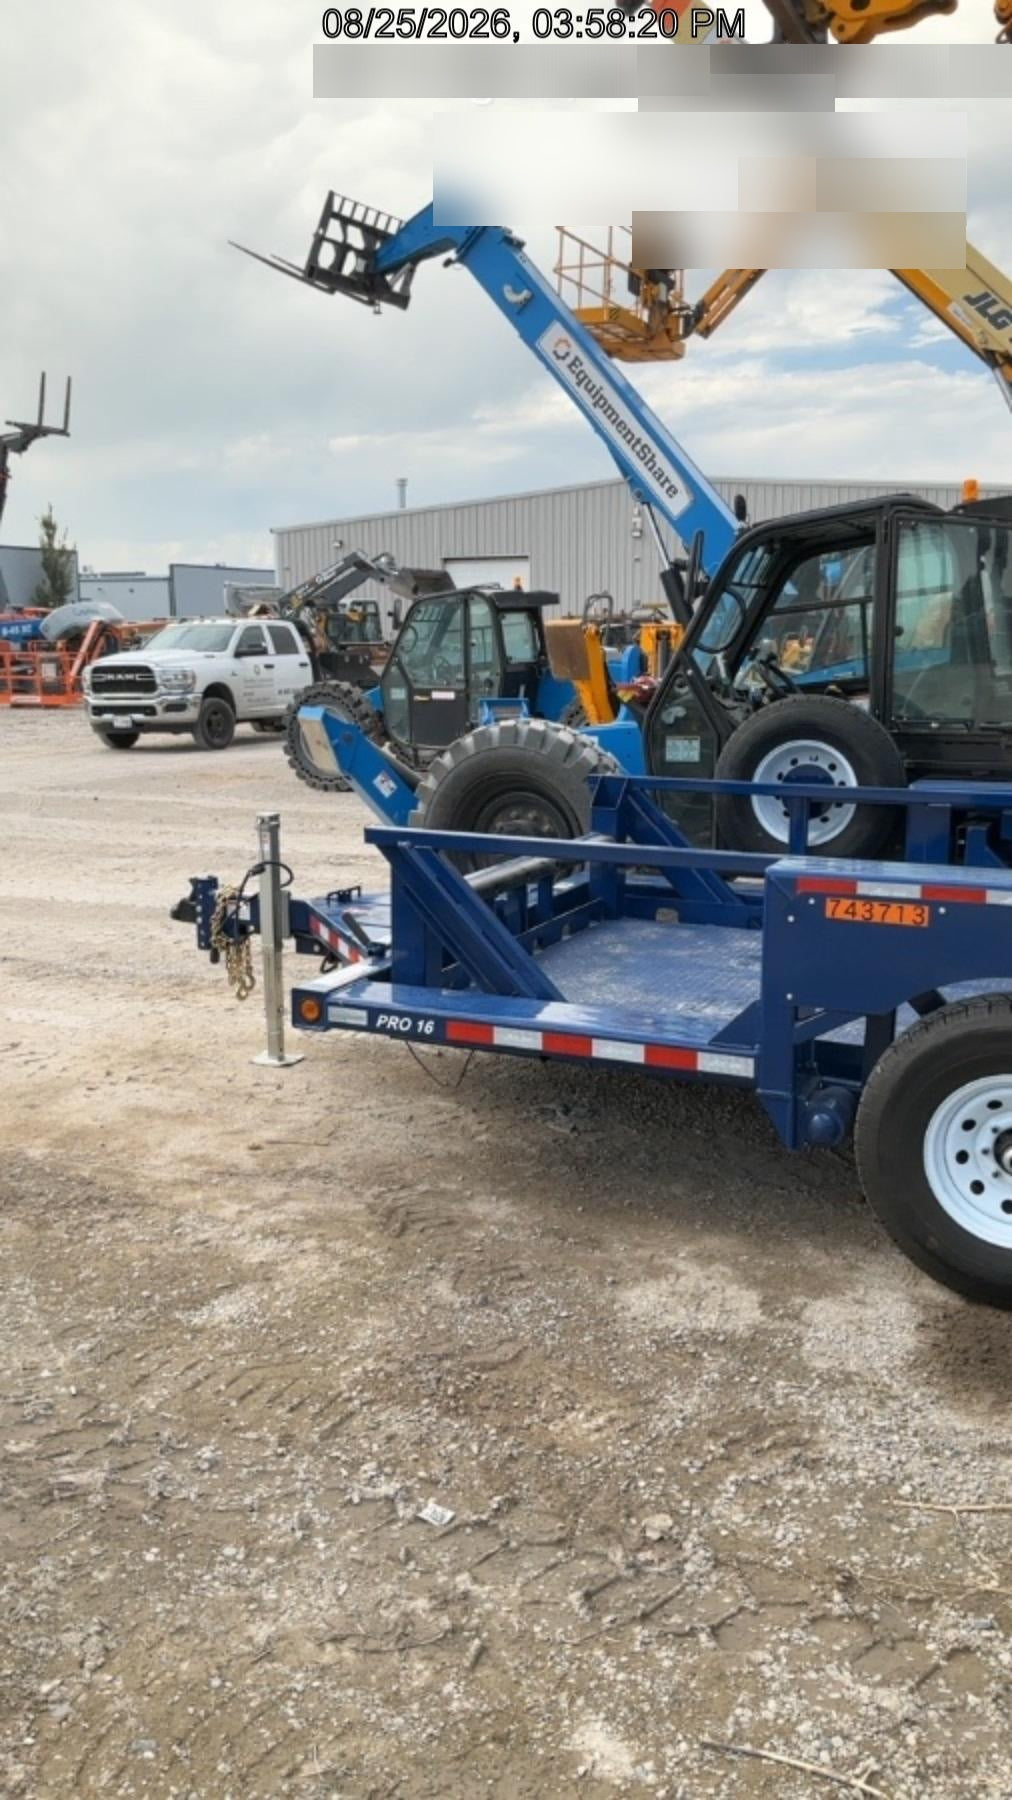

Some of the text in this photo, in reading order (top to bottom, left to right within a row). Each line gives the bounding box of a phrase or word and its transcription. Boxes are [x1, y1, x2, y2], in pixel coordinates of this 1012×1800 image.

[962, 291, 1012, 331] JLG
[567, 356, 679, 498] EquipmentShare
[107, 673, 134, 681] RAM
[829, 899, 925, 925] 743713
[376, 1014, 435, 1035] PRO 16
